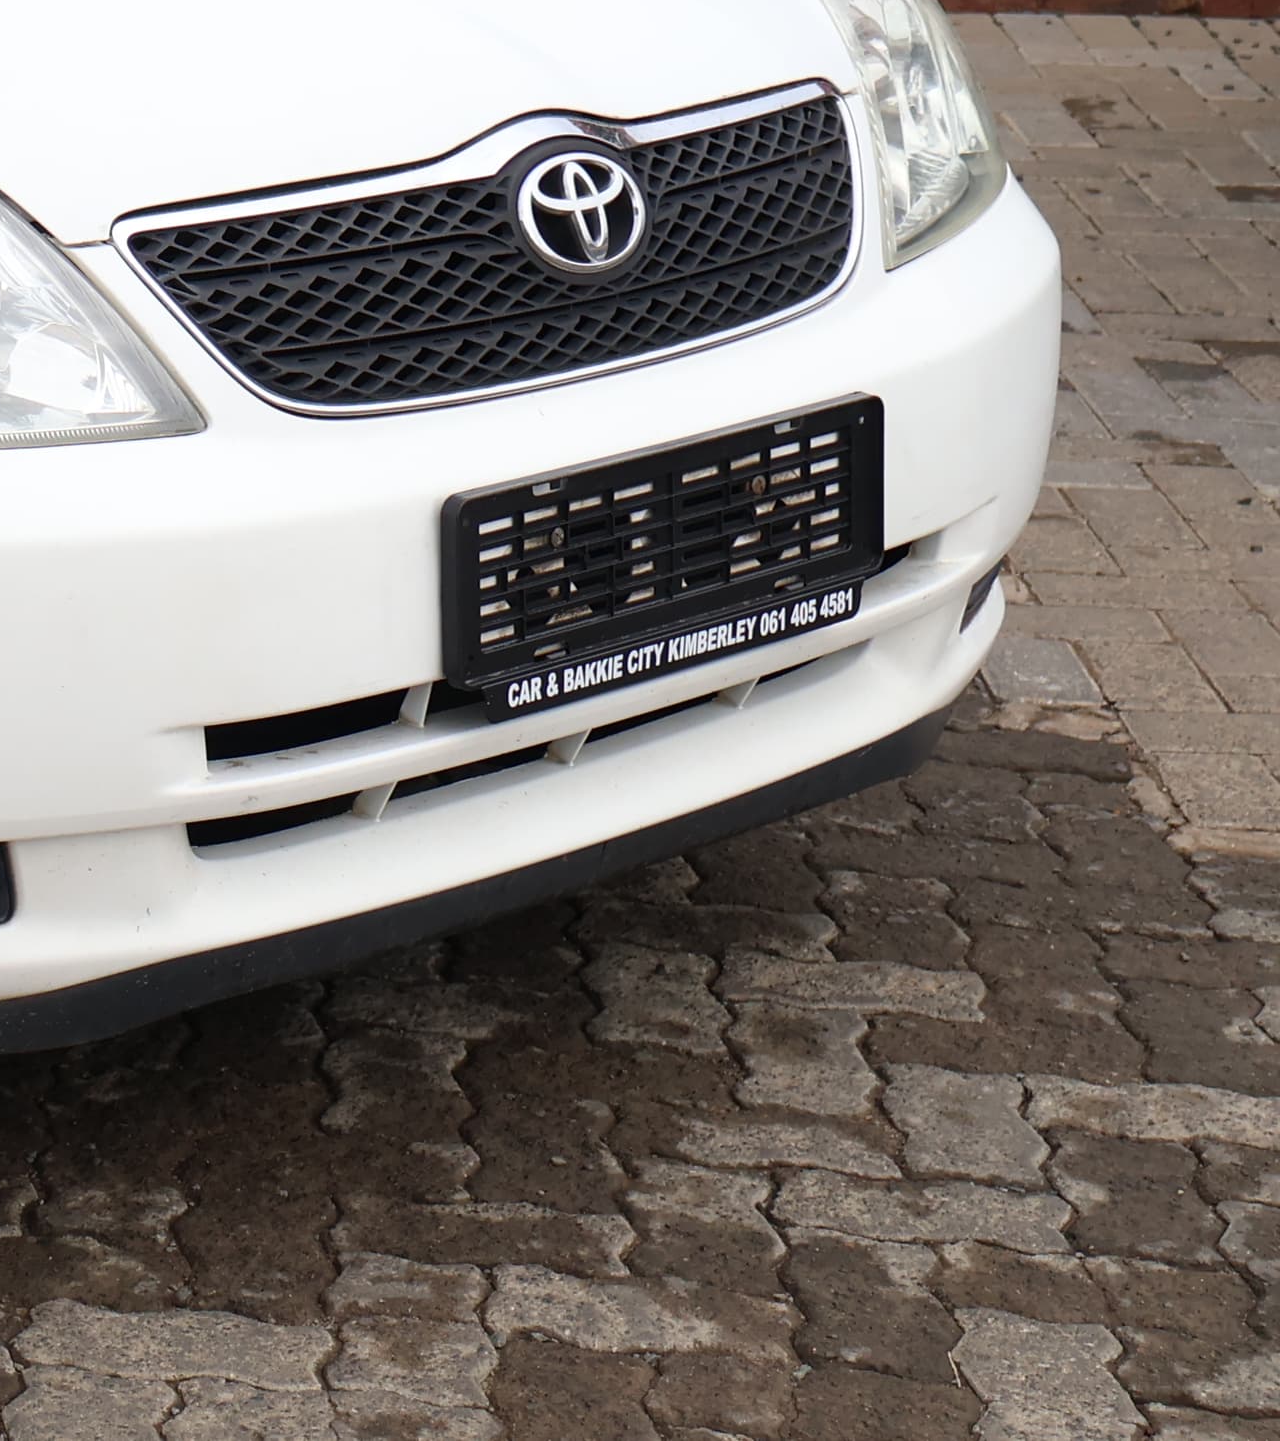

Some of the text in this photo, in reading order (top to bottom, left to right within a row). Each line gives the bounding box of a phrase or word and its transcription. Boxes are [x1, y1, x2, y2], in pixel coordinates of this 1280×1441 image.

[507, 587, 854, 709] CAR & BAKKIE CITY KIMBERLEY 061 405 4581
